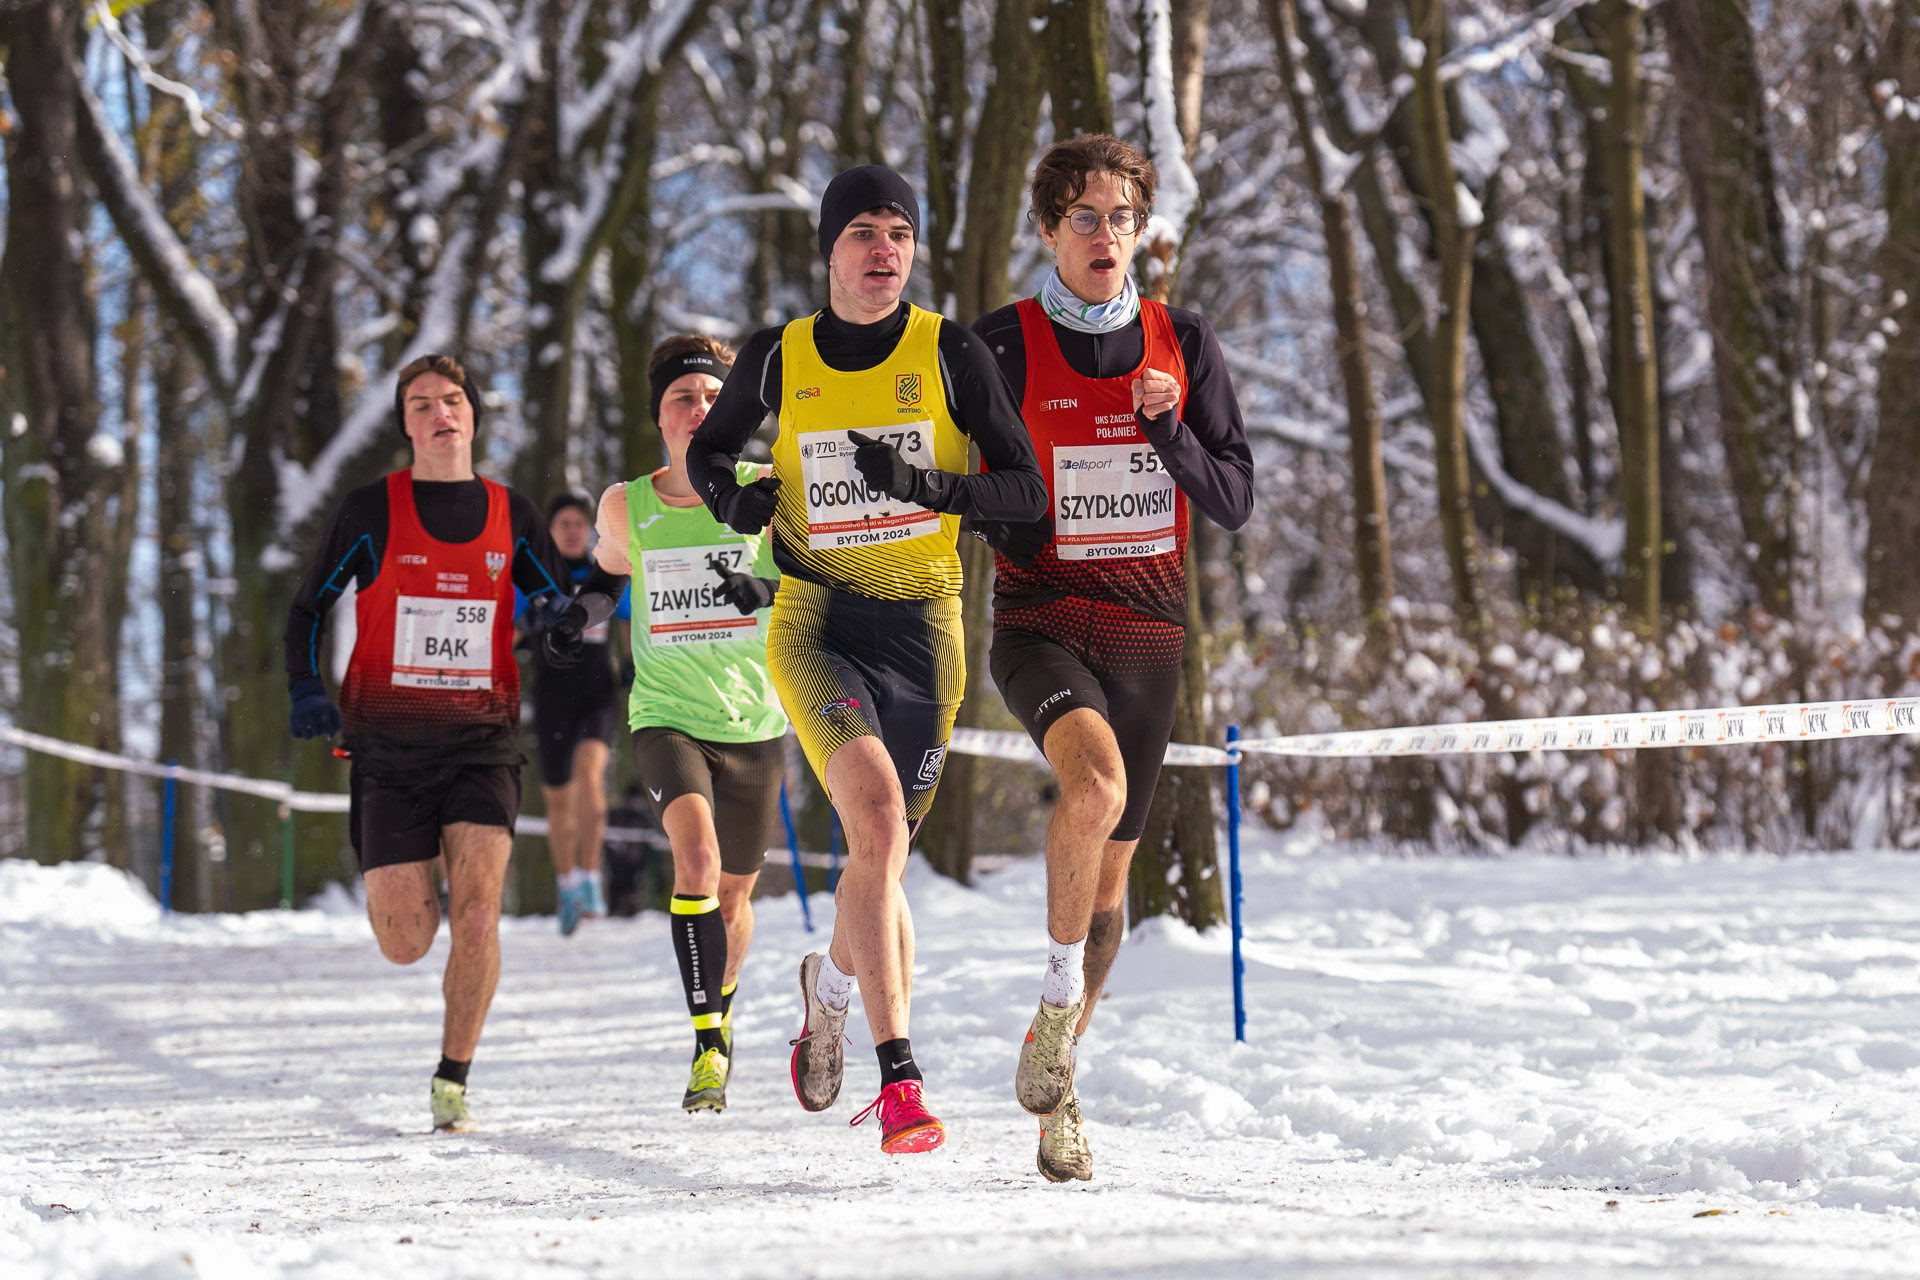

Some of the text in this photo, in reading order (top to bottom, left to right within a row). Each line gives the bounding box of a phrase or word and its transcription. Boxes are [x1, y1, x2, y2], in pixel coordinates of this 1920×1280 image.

[683, 357, 713, 366] KALENJI
[1095, 413, 1136, 425] UKS ŻACZEK
[1096, 425, 1137, 439] POŁANIEC
[815, 441, 836, 454] 770
[877, 430, 922, 453] 73
[1064, 458, 1113, 471] Bellsport
[1129, 451, 1164, 474] 55
[1060, 487, 1173, 520] SZYDŁOWSKI
[883, 517, 905, 527] Biegach
[837, 528, 912, 545] BYTOM 2024
[1131, 532, 1152, 541] Biegach
[1087, 544, 1156, 557] BYTOM 2024
[704, 550, 743, 570] 157
[456, 606, 487, 623] 558
[672, 631, 733, 643] BYTOM 2024
[425, 637, 469, 661] BĄK
[416, 677, 449, 687] BYTOM
[686, 921, 701, 990] COMPRESSPORT
